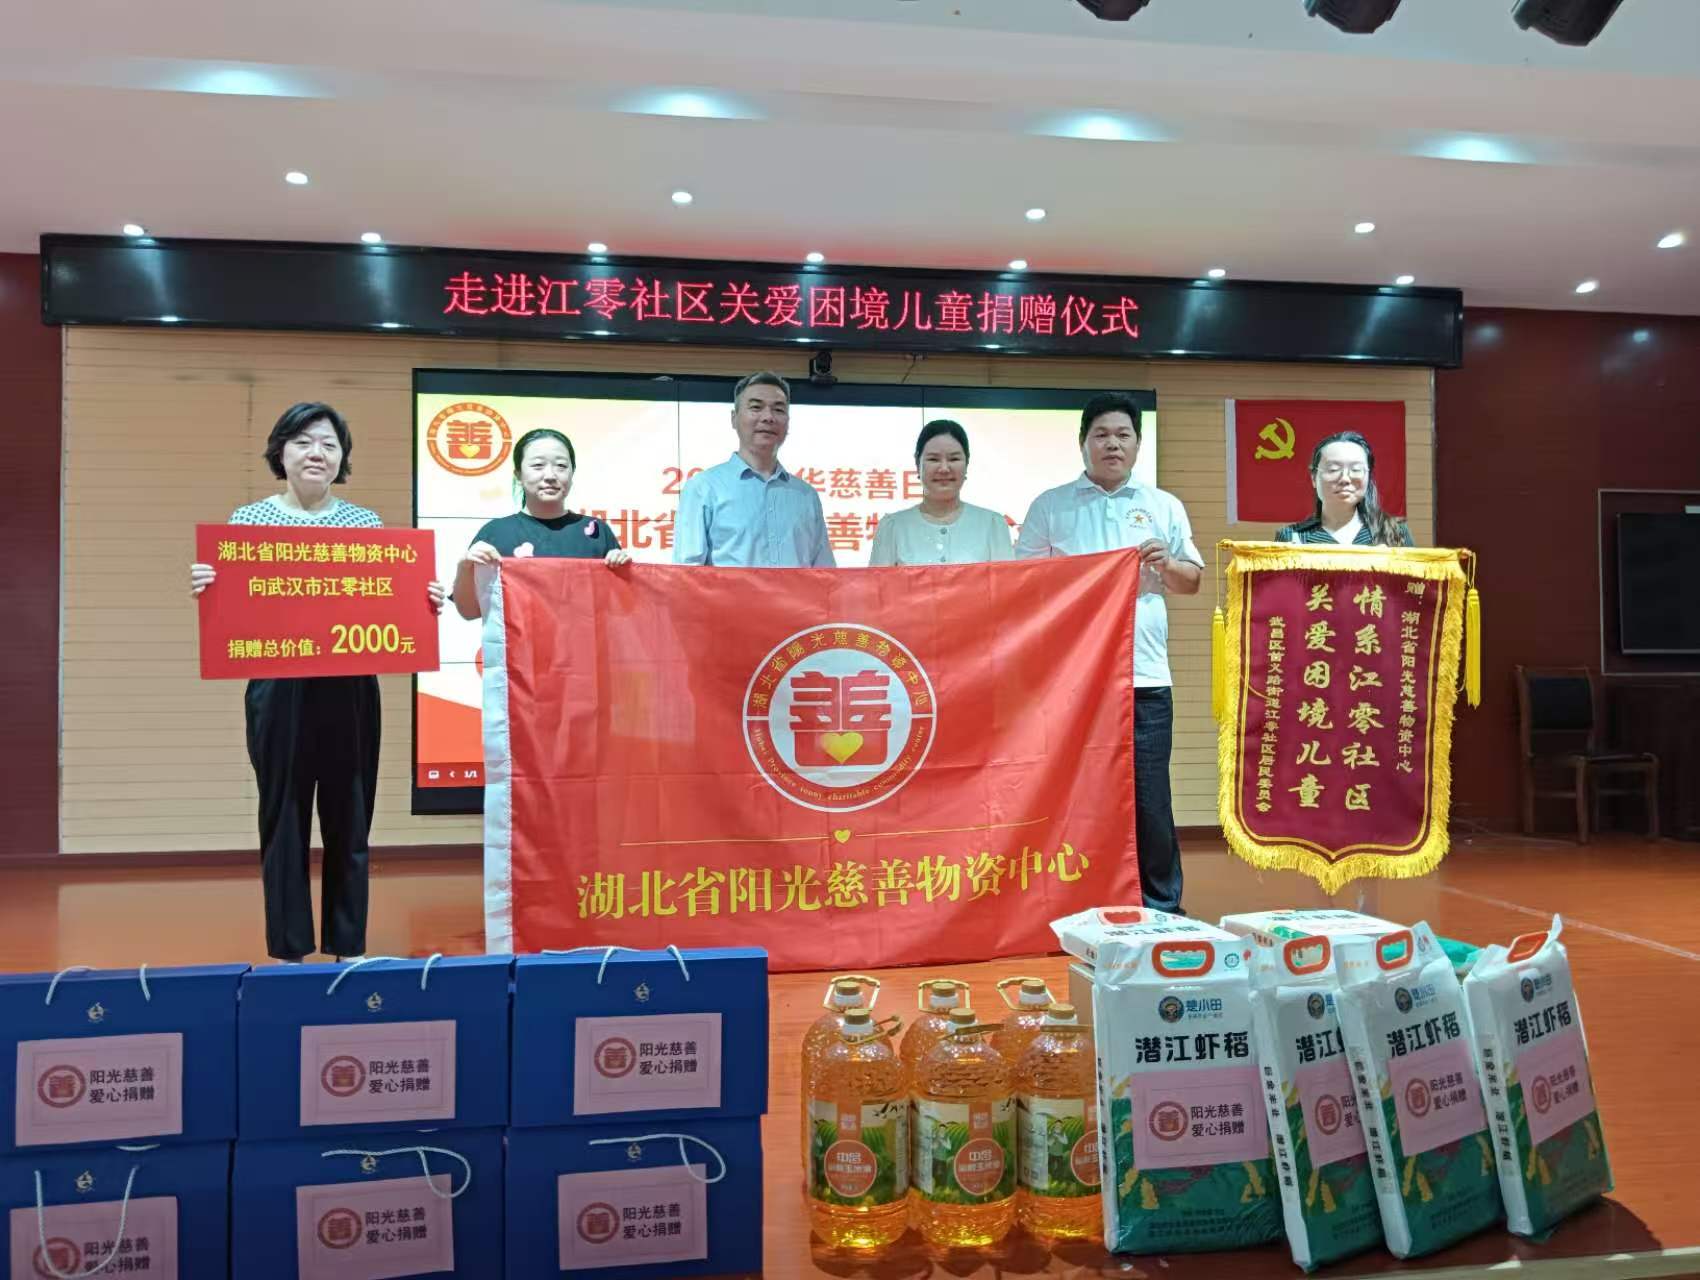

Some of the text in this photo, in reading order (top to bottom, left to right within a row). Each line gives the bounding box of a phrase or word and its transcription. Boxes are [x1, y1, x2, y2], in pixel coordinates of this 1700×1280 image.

[444, 272, 1138, 337] 走进江零社区关爱困境儿童捐赠仪式
[218, 541, 418, 563] 湖北省阳光慈善物资中心
[249, 576, 394, 597] 向武汉市江零社区
[1288, 583, 1336, 808] 关爱困境儿童
[1341, 586, 1387, 811] 情系江零社区
[577, 843, 1089, 920] 湖北省阳光慈善物资中心
[1514, 1000, 1571, 1046] 潜江虾稻
[1387, 1011, 1460, 1058] 潜江虾稻
[639, 1041, 697, 1057] 阳光慈善
[1135, 1031, 1249, 1064] 潜江虾稻
[89, 1066, 155, 1085] 阳光慈善
[369, 1058, 430, 1076] 阳光慈善
[639, 1059, 697, 1075] 爱心捐赠
[89, 1085, 155, 1104] 爱心捐赠
[368, 1076, 431, 1094] 爱心捐赠
[1190, 1103, 1244, 1120] 阳光慈善
[1192, 1122, 1245, 1138] 爱心捐赠
[366, 1207, 426, 1224] 阳光慈善
[623, 1204, 681, 1220] 阳光慈善
[366, 1225, 427, 1243] 爱心捐赠
[623, 1222, 682, 1239] 爱心捐赠
